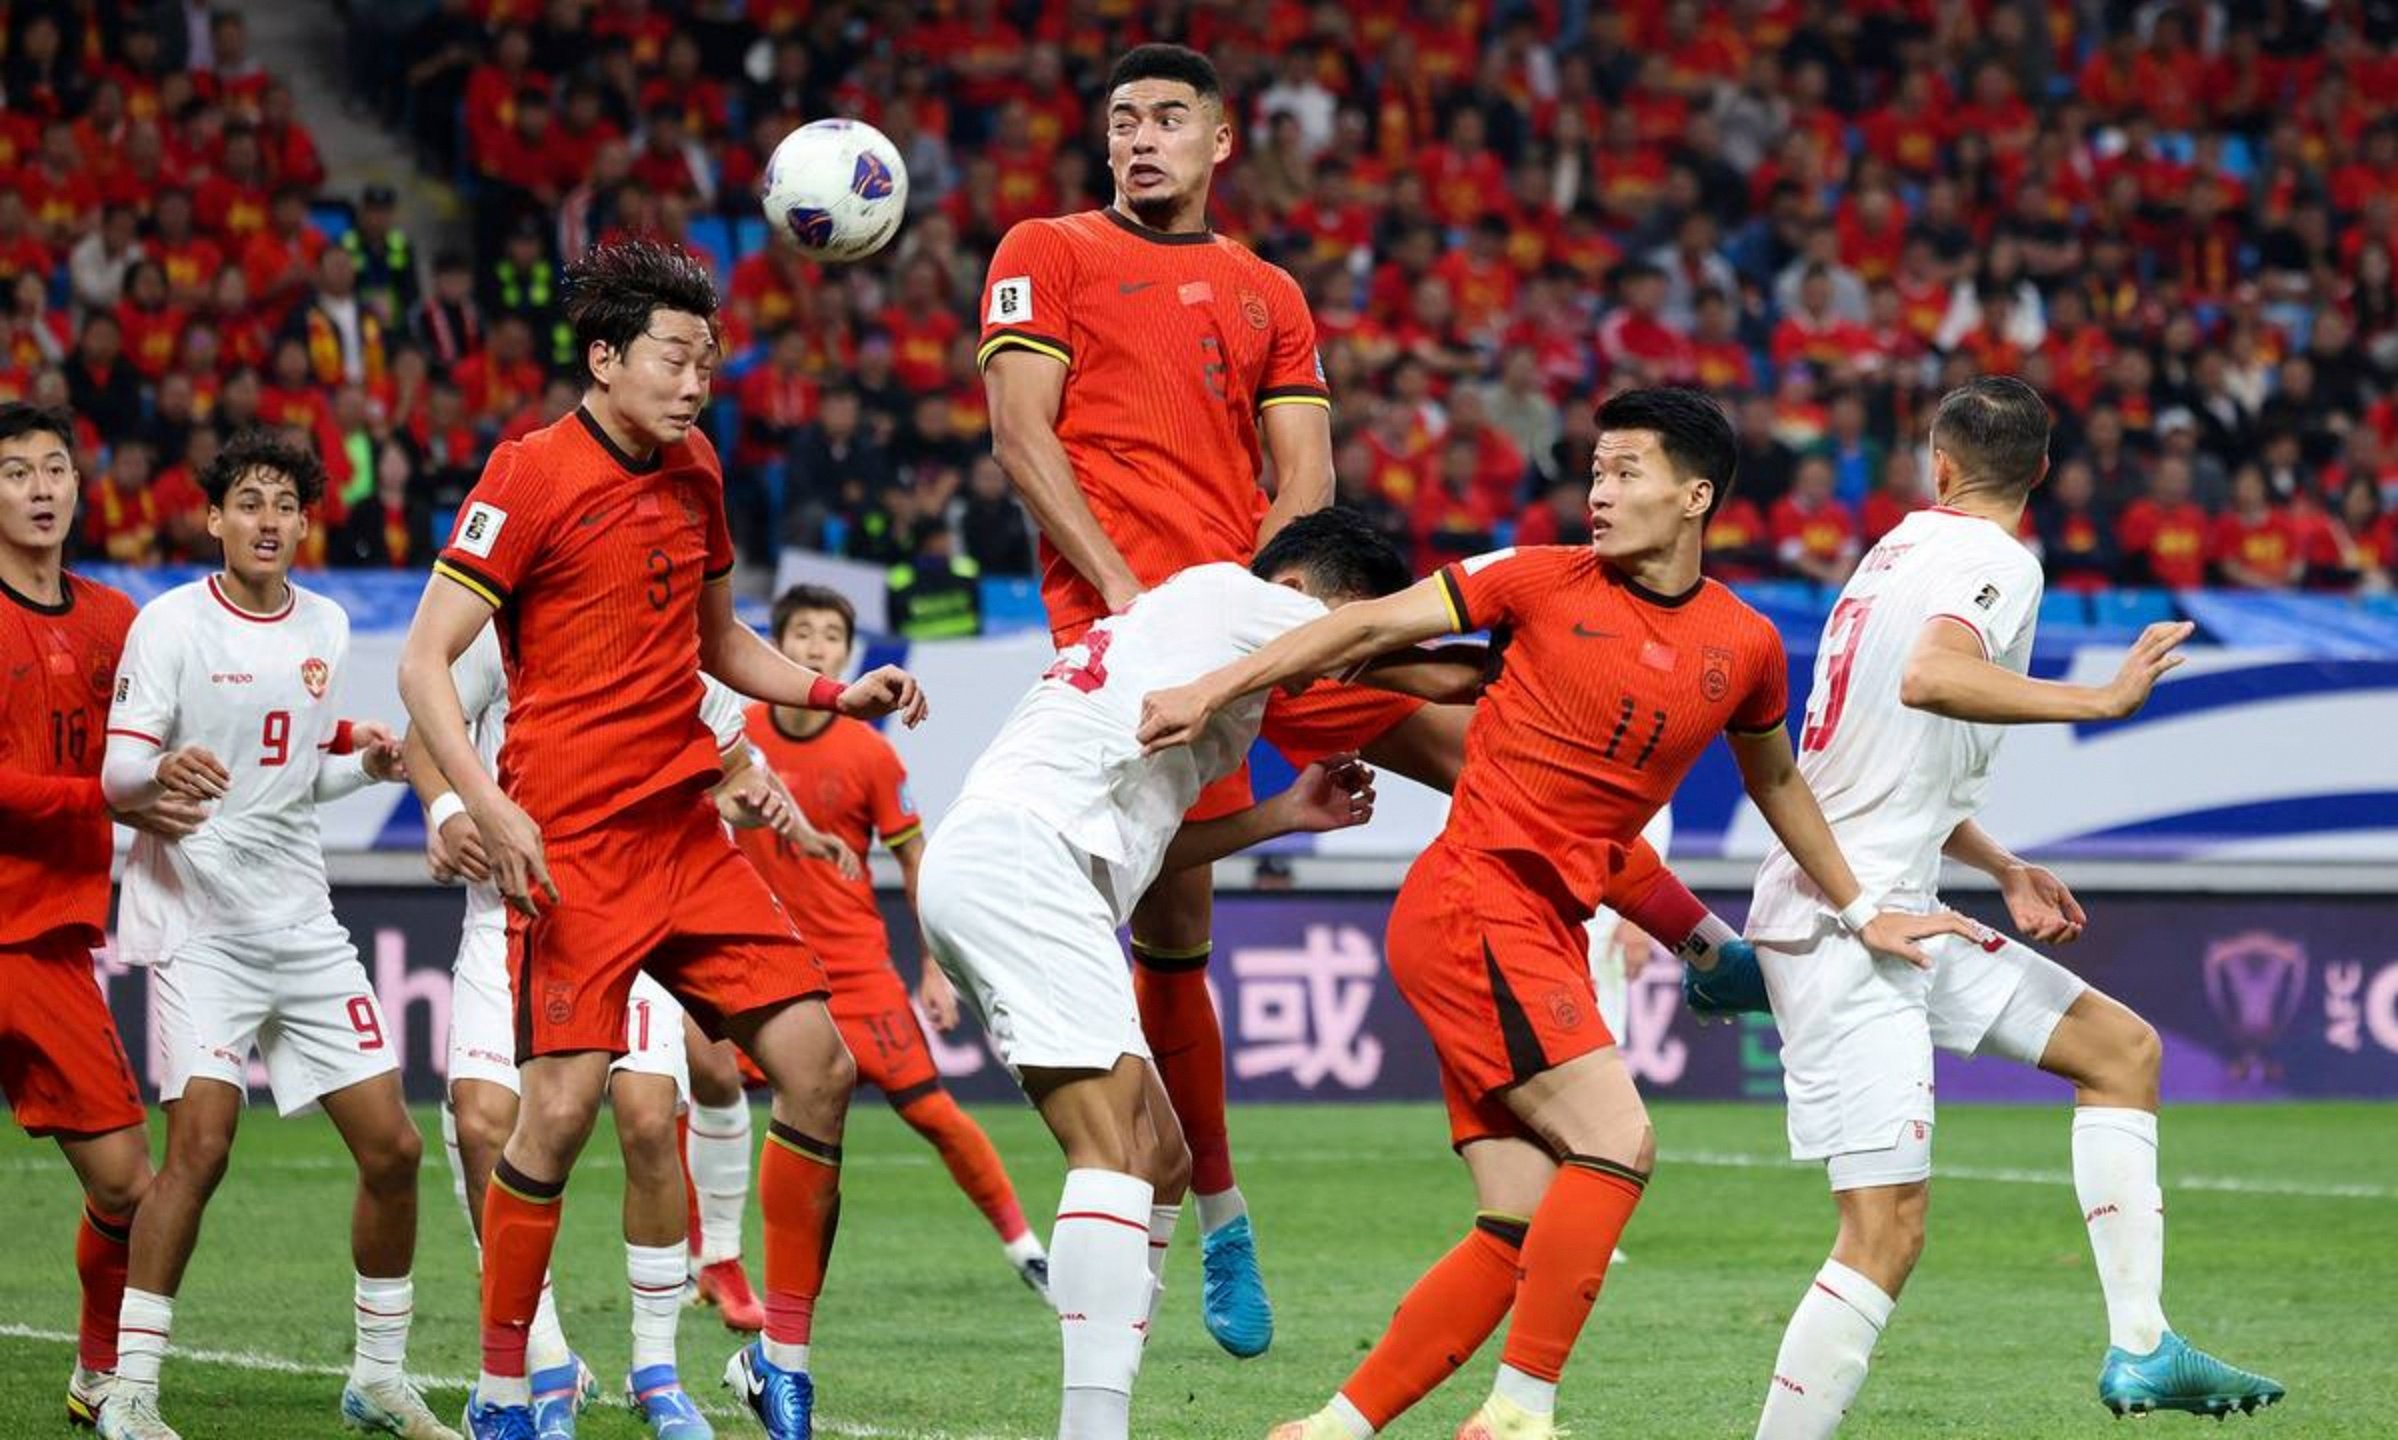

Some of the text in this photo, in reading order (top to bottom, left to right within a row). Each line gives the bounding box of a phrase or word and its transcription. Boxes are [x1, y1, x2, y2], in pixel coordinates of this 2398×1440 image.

[647, 548, 673, 611] 3
[1803, 594, 1877, 752] 3
[51, 708, 88, 768] 16
[259, 710, 290, 767] 9
[1603, 696, 1667, 770] 11
[346, 996, 384, 1050] 9
[864, 1010, 912, 1058] 10
[2325, 960, 2361, 1052] AFC
